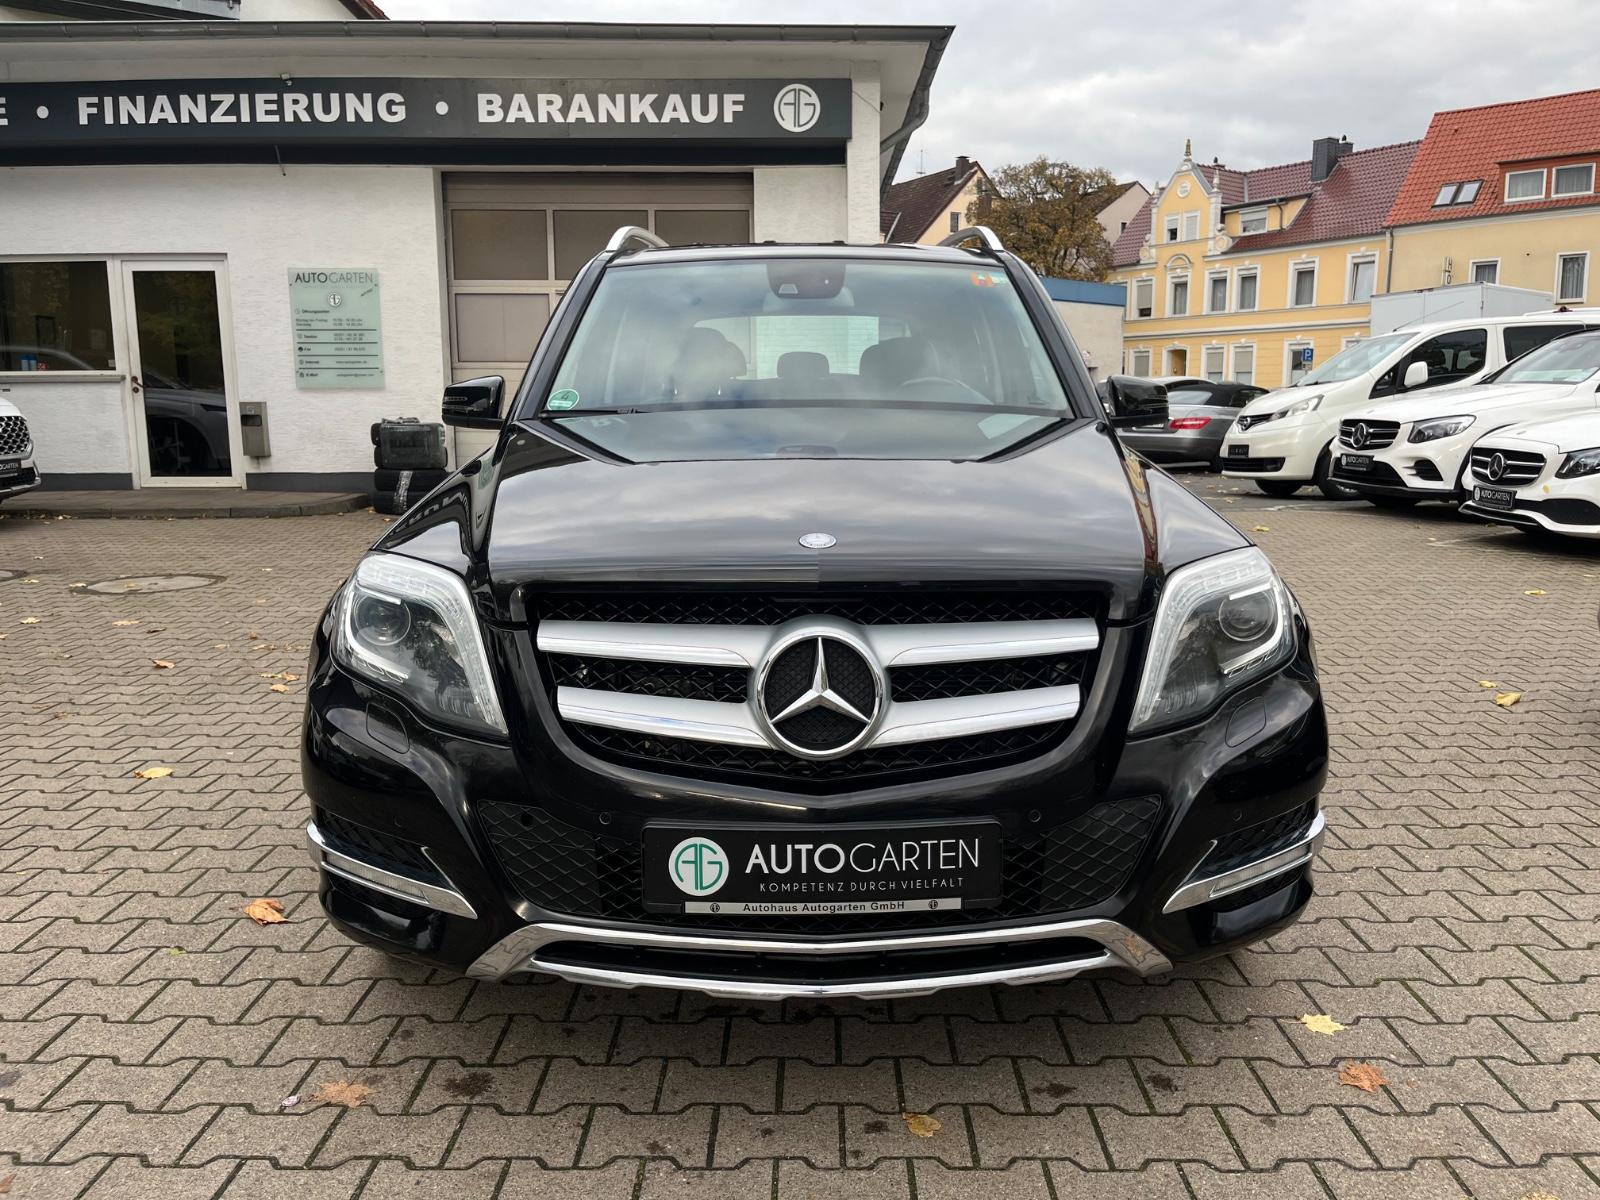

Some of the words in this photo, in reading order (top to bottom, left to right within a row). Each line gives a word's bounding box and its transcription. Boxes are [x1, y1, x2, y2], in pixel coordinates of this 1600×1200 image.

[77, 92, 407, 126] FINANZIERUNG
[477, 93, 746, 123] BARANKAUF
[295, 272, 373, 284] AUTOGARTEN
[1304, 349, 1312, 360] P
[745, 838, 979, 874] AUTOGARTEN
[759, 882, 844, 892] KOMPETENZ
[851, 880, 896, 891] DURCH
[901, 877, 964, 890] VIELFALT
[742, 903, 798, 912] Autohaus
[802, 902, 866, 914] Autogarten
[870, 901, 905, 911] GmbH
